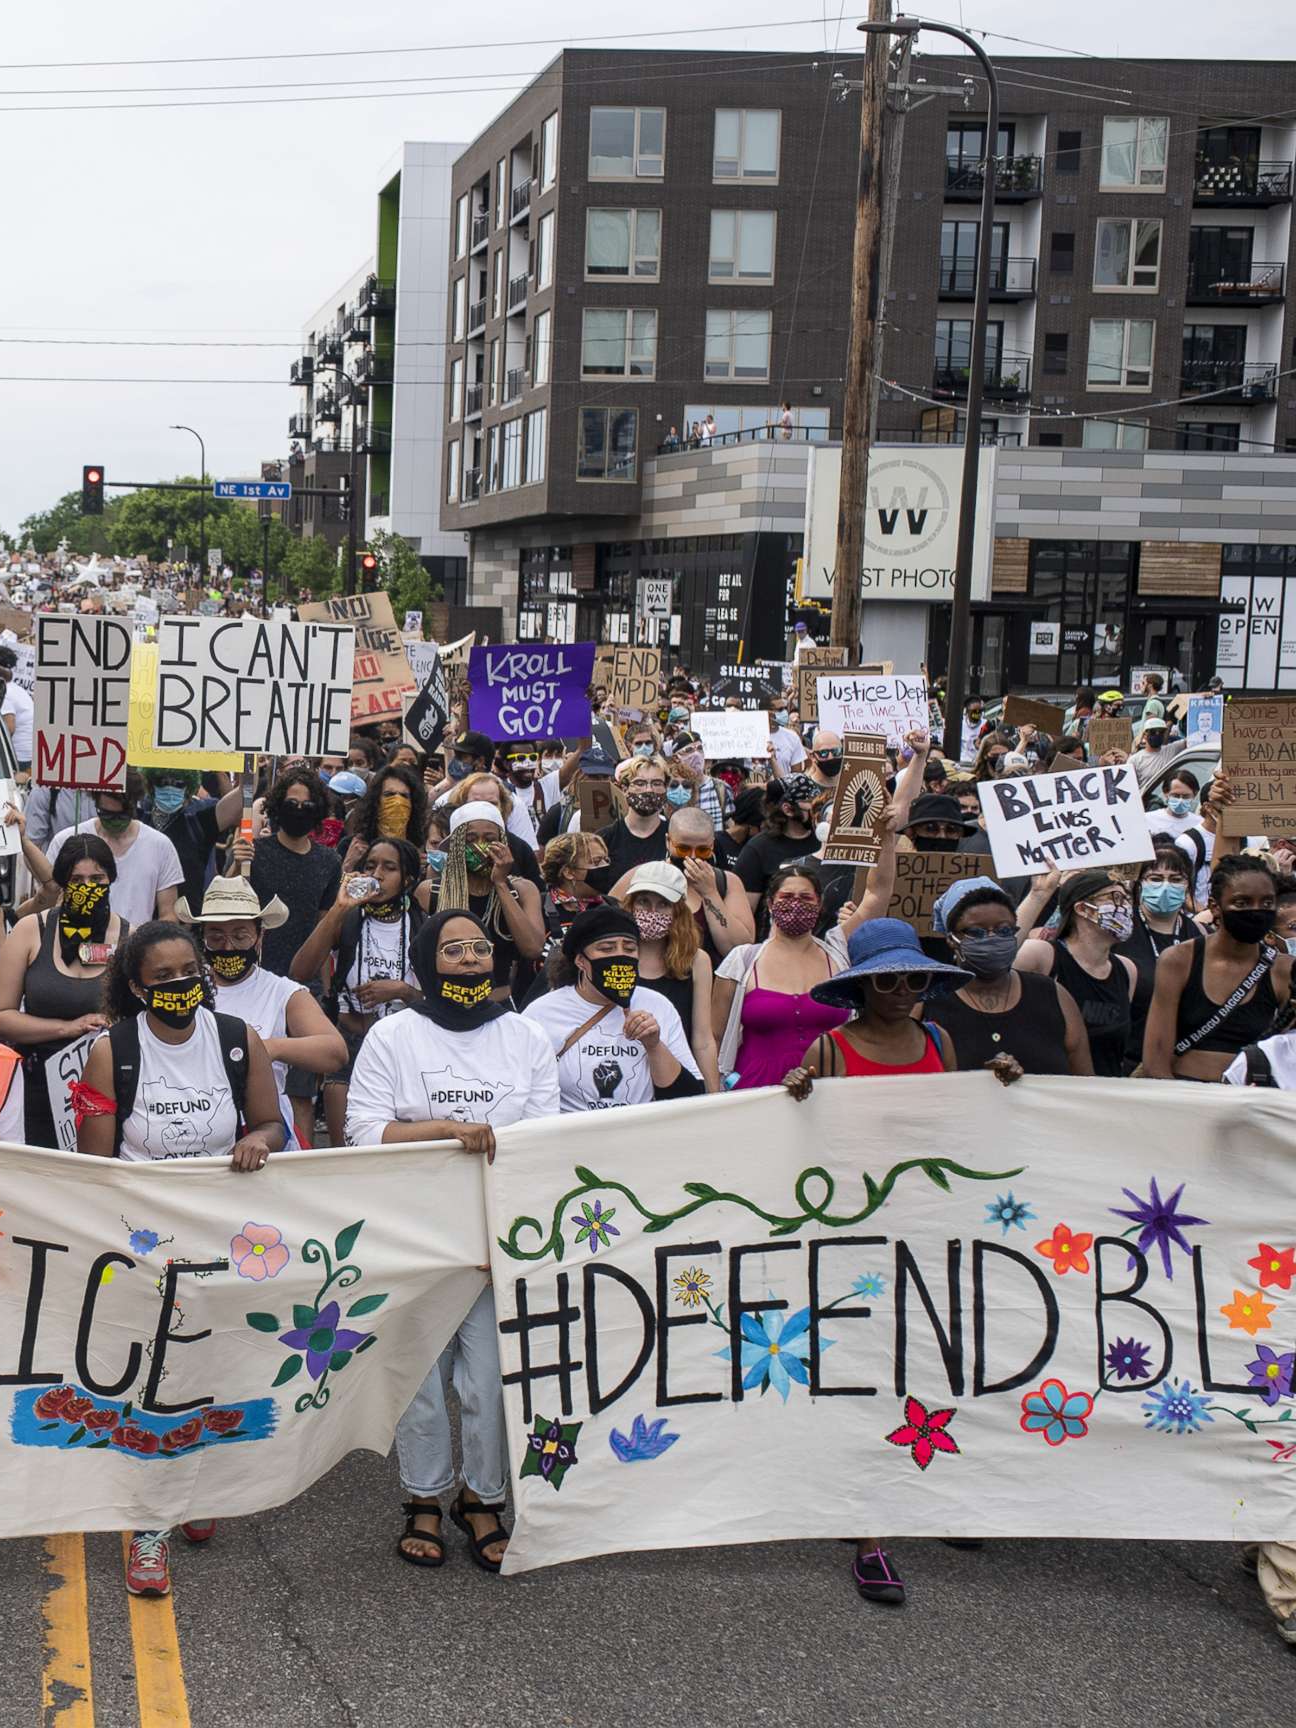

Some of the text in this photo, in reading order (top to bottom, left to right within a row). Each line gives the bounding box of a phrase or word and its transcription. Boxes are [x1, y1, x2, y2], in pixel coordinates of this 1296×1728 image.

[220, 485, 285, 497] NE 1st Av
[647, 583, 668, 593] ONE
[718, 588, 730, 601] FOR
[647, 594, 669, 603] WAY
[1219, 618, 1277, 635] OPEN
[38, 617, 131, 671] END
[160, 620, 353, 681] I CAN'T
[486, 651, 573, 687] KROLL
[616, 651, 659, 678] END
[720, 665, 770, 679] SILENCE
[502, 681, 560, 704] MUST
[613, 679, 657, 705] MPD
[739, 681, 753, 693] IS
[823, 679, 892, 702] Justice
[895, 679, 928, 705] Dept
[37, 676, 130, 727] THE
[352, 685, 416, 717] EAC
[157, 673, 352, 756] BREATHE
[498, 698, 562, 737] GO!
[839, 703, 864, 719] The
[1229, 705, 1278, 720] Some
[1232, 722, 1283, 740] have a
[37, 729, 127, 786] MPD
[847, 741, 885, 755] KOREANS FOR
[1248, 742, 1275, 761] BAD
[1259, 763, 1284, 781] they
[993, 767, 1131, 822] BLACK
[1233, 782, 1284, 801] #BLM
[824, 848, 876, 862] BLACK LIVES
[897, 856, 980, 877] BOLISH
[905, 877, 949, 894] THE
[887, 894, 934, 917] POL
[153, 983, 201, 1002] DEFUND
[441, 987, 492, 1005] POLICE
[442, 979, 491, 995] DEFUND
[603, 983, 635, 991] PEOPL
[152, 991, 204, 1011] POLICE
[1219, 988, 1246, 1017] BAGGU
[1190, 1015, 1221, 1042] BAGGU
[581, 1045, 639, 1057] #DEFUND
[430, 1089, 494, 1103] #DEFUND
[149, 1098, 211, 1115] #DEFUND
